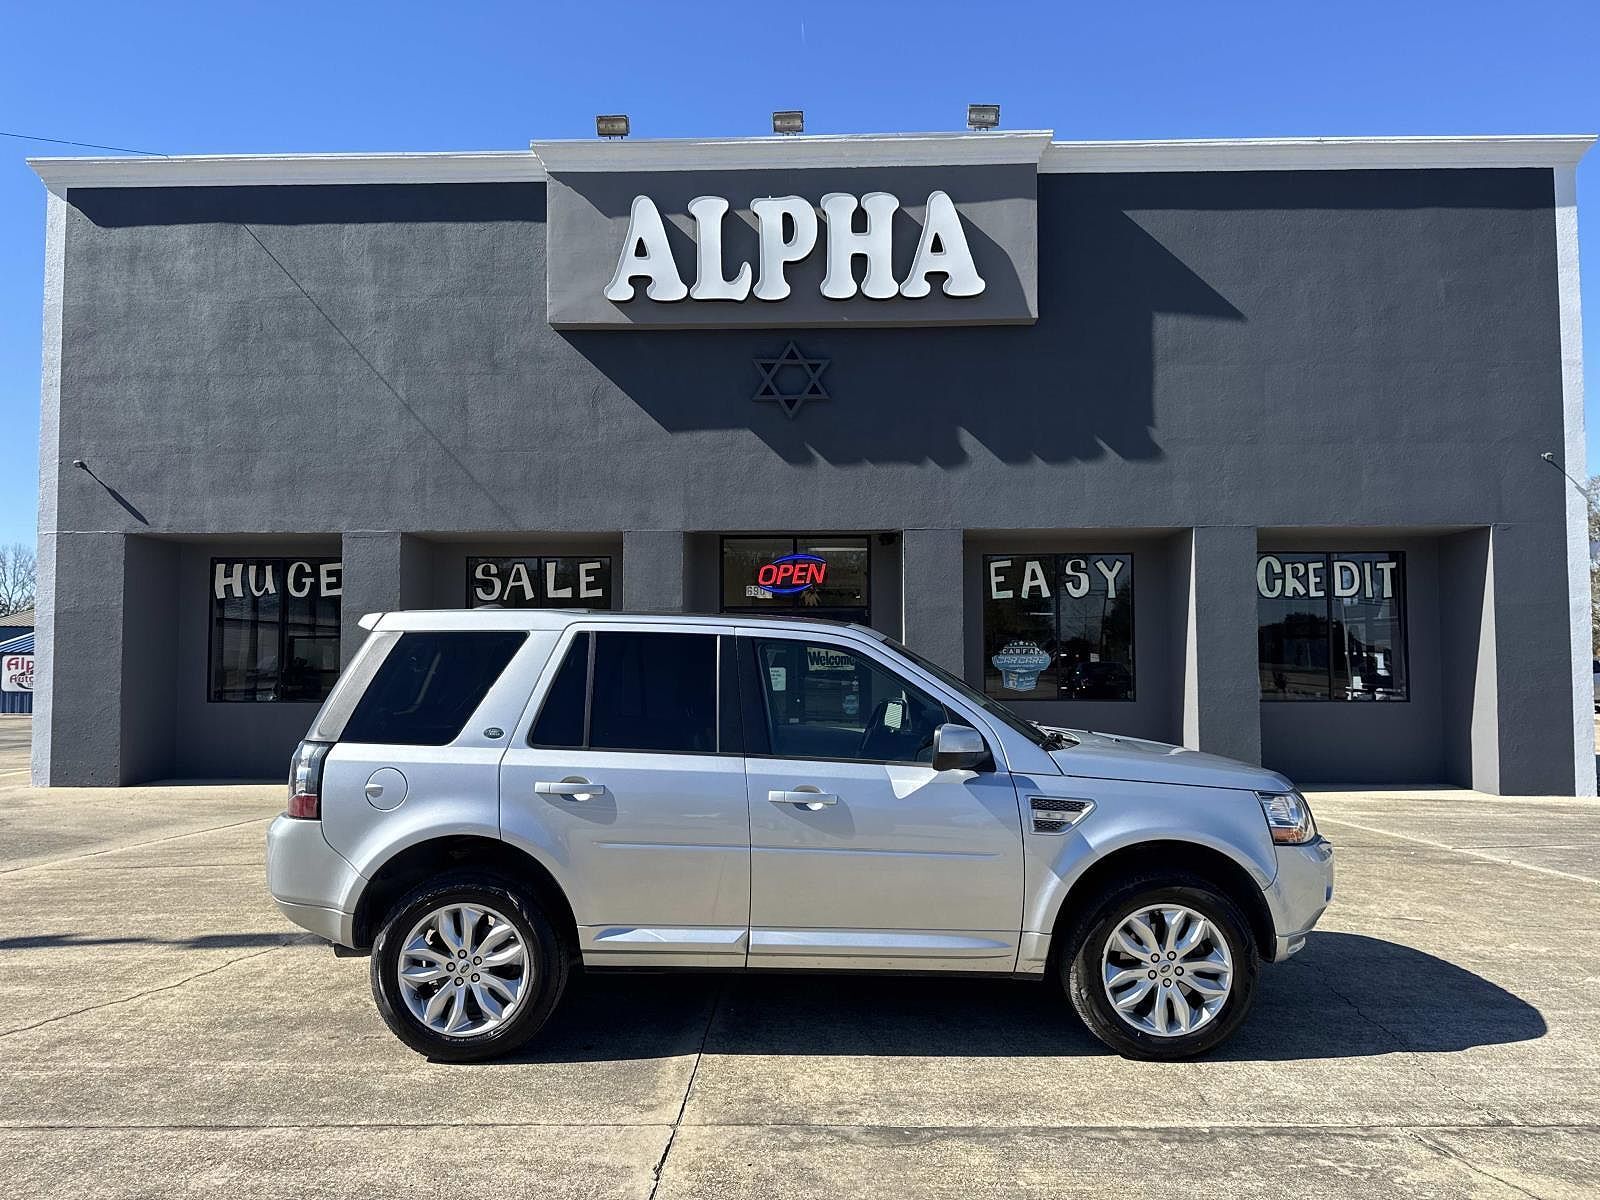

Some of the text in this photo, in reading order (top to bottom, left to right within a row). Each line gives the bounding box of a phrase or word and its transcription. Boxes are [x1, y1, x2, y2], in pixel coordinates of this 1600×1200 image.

[603, 190, 986, 301] ALPHA
[214, 561, 342, 599] HUGE
[474, 560, 603, 600] SALE
[758, 563, 827, 585] OPEN
[990, 559, 1123, 599] EASY
[1257, 555, 1397, 598] CREDIT
[808, 651, 855, 666] Welcome
